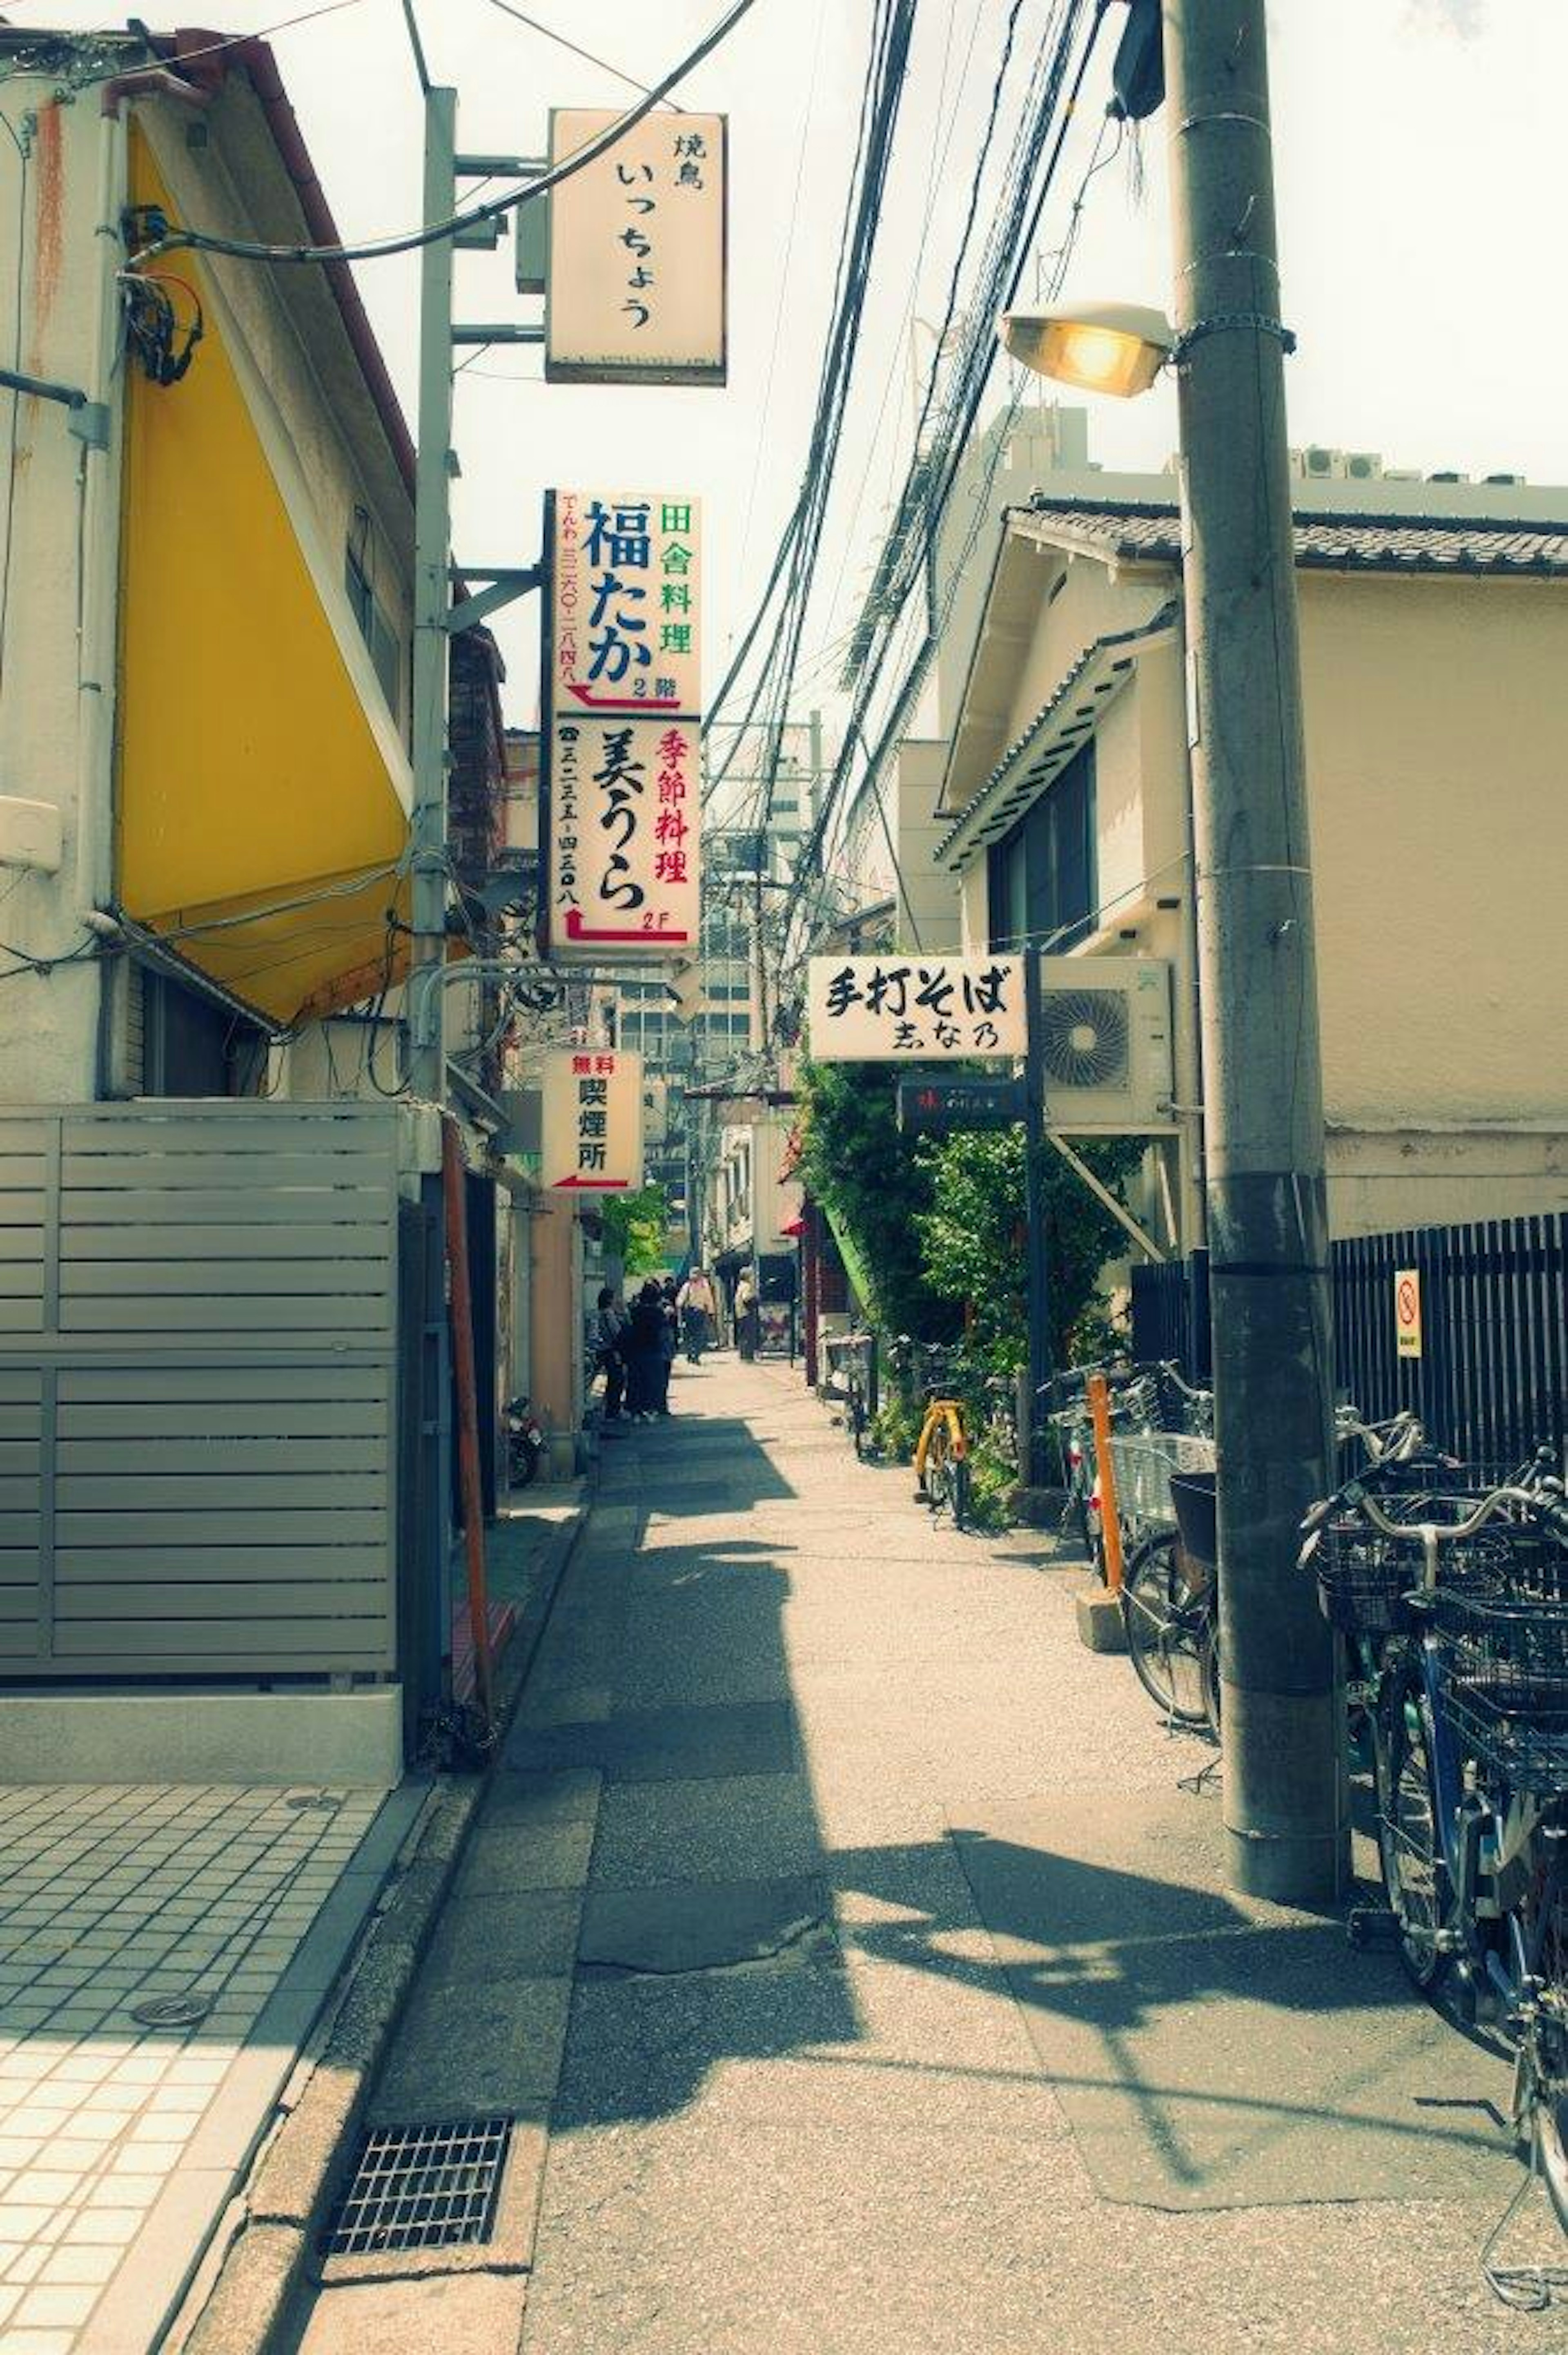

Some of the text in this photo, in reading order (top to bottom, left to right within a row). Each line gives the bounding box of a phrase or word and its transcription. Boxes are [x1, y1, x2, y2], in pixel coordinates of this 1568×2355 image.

[673, 133, 706, 190] 焼鳥
[616, 163, 655, 329] いっちょう
[581, 500, 652, 682] 福たか
[660, 504, 692, 653] 田舎料理
[593, 728, 645, 909] 美うら
[656, 728, 689, 884] 季節料理
[644, 912, 669, 929] 2F
[826, 966, 1012, 1017] 手打そば
[572, 1056, 613, 1075] 無料
[579, 1079, 607, 1171] 喫煙所
